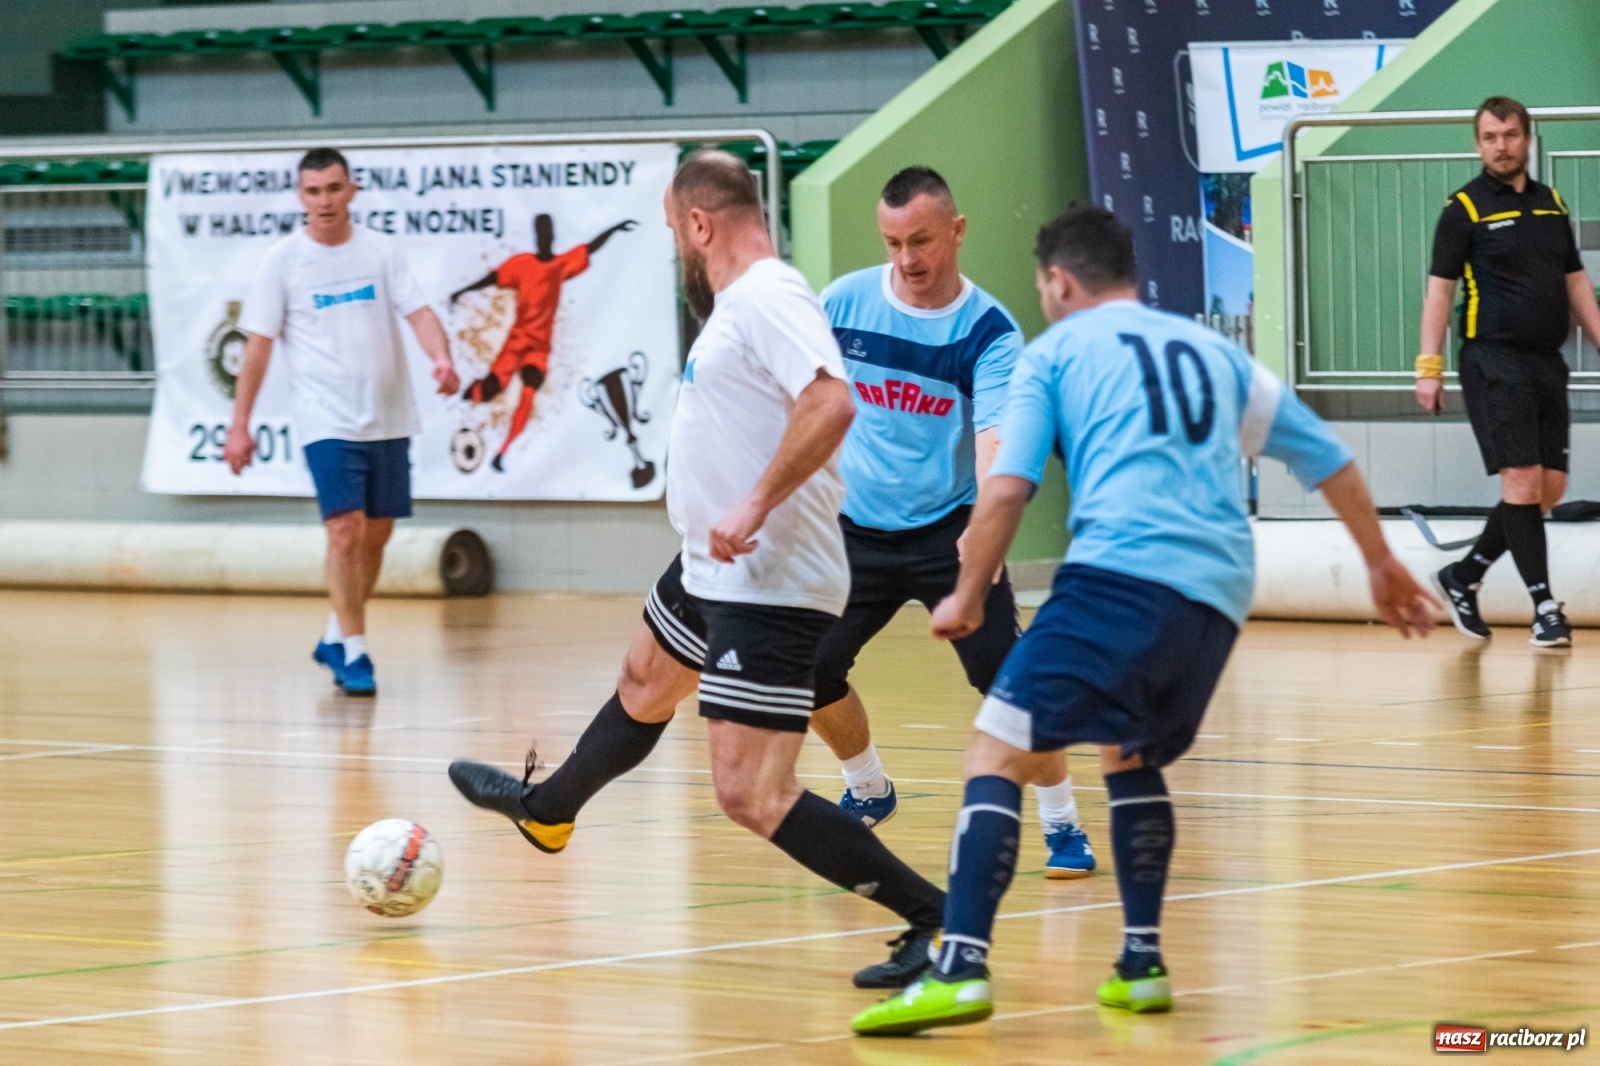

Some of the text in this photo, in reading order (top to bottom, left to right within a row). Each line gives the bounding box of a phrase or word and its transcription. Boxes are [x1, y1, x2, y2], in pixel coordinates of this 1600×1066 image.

[179, 170, 295, 195] MEMORIA
[416, 165, 482, 197] JANA
[491, 160, 636, 189] STANIENDY
[179, 211, 202, 237] W
[404, 203, 505, 239] NOŻNEJ
[1117, 332, 1216, 445] 10
